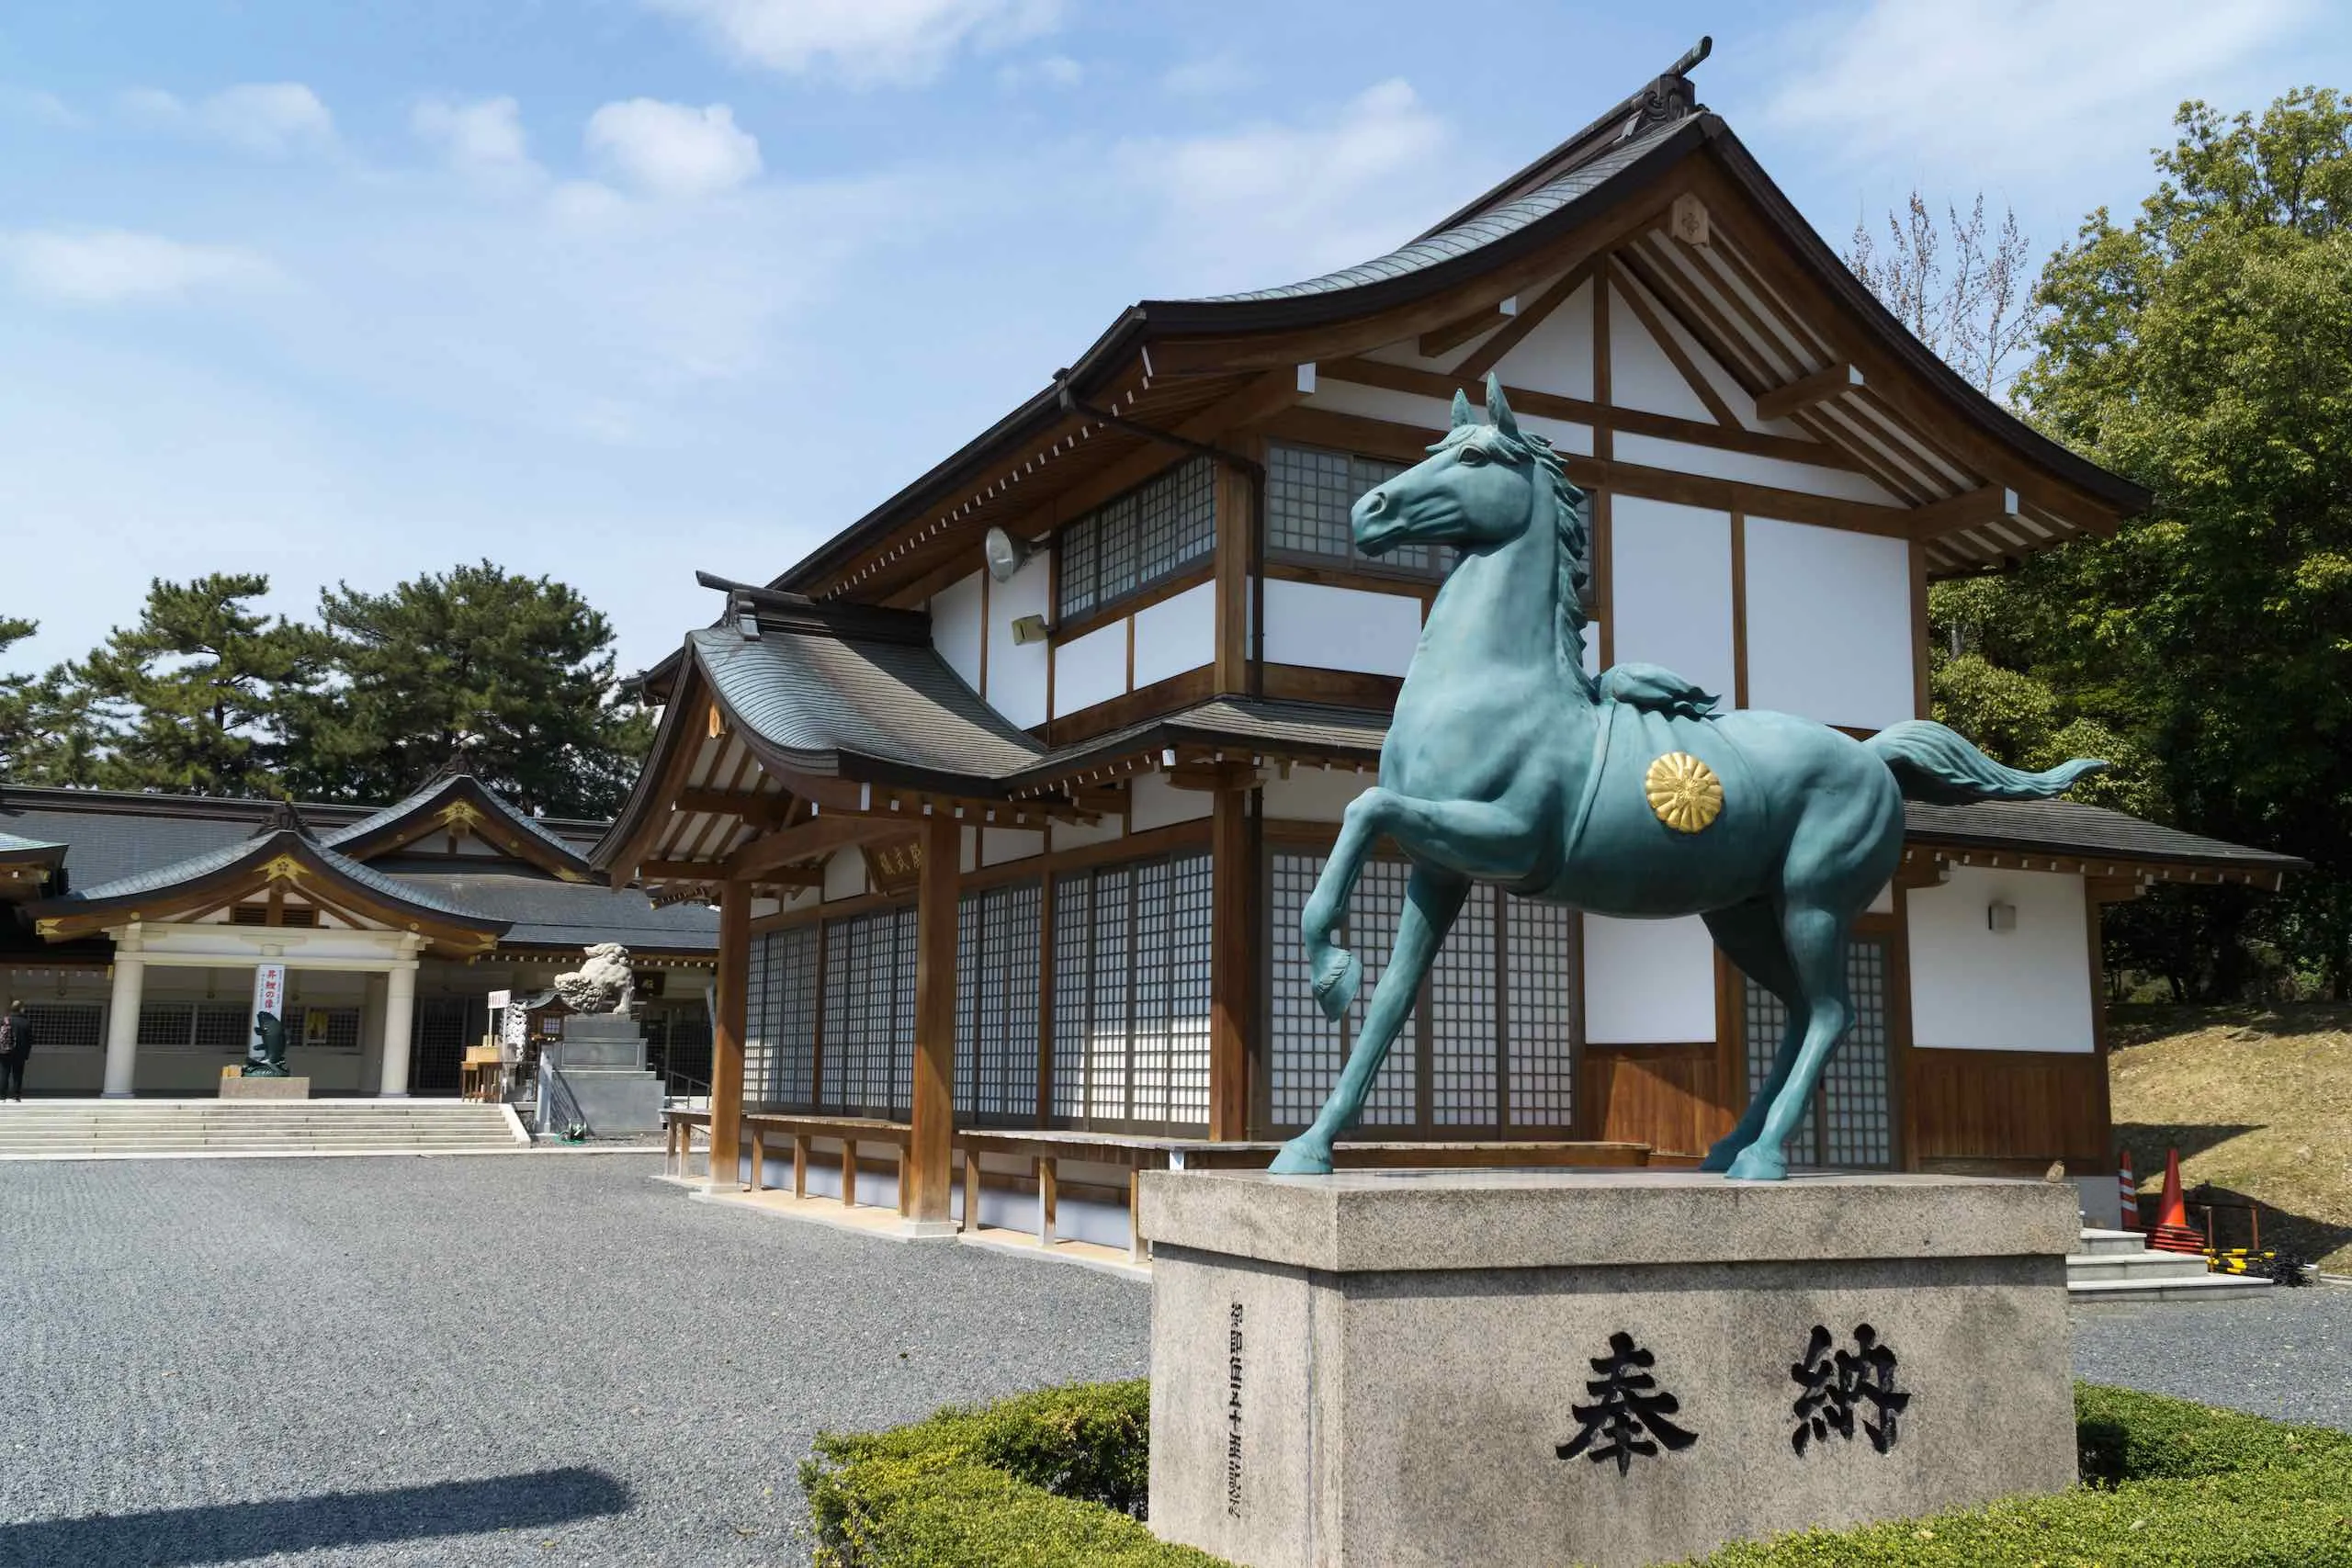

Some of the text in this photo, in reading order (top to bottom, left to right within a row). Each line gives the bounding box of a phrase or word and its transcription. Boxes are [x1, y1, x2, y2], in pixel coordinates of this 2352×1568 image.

[265, 969, 276, 1012] 昇鯉の像
[1555, 1323, 1911, 1476] 奉納
